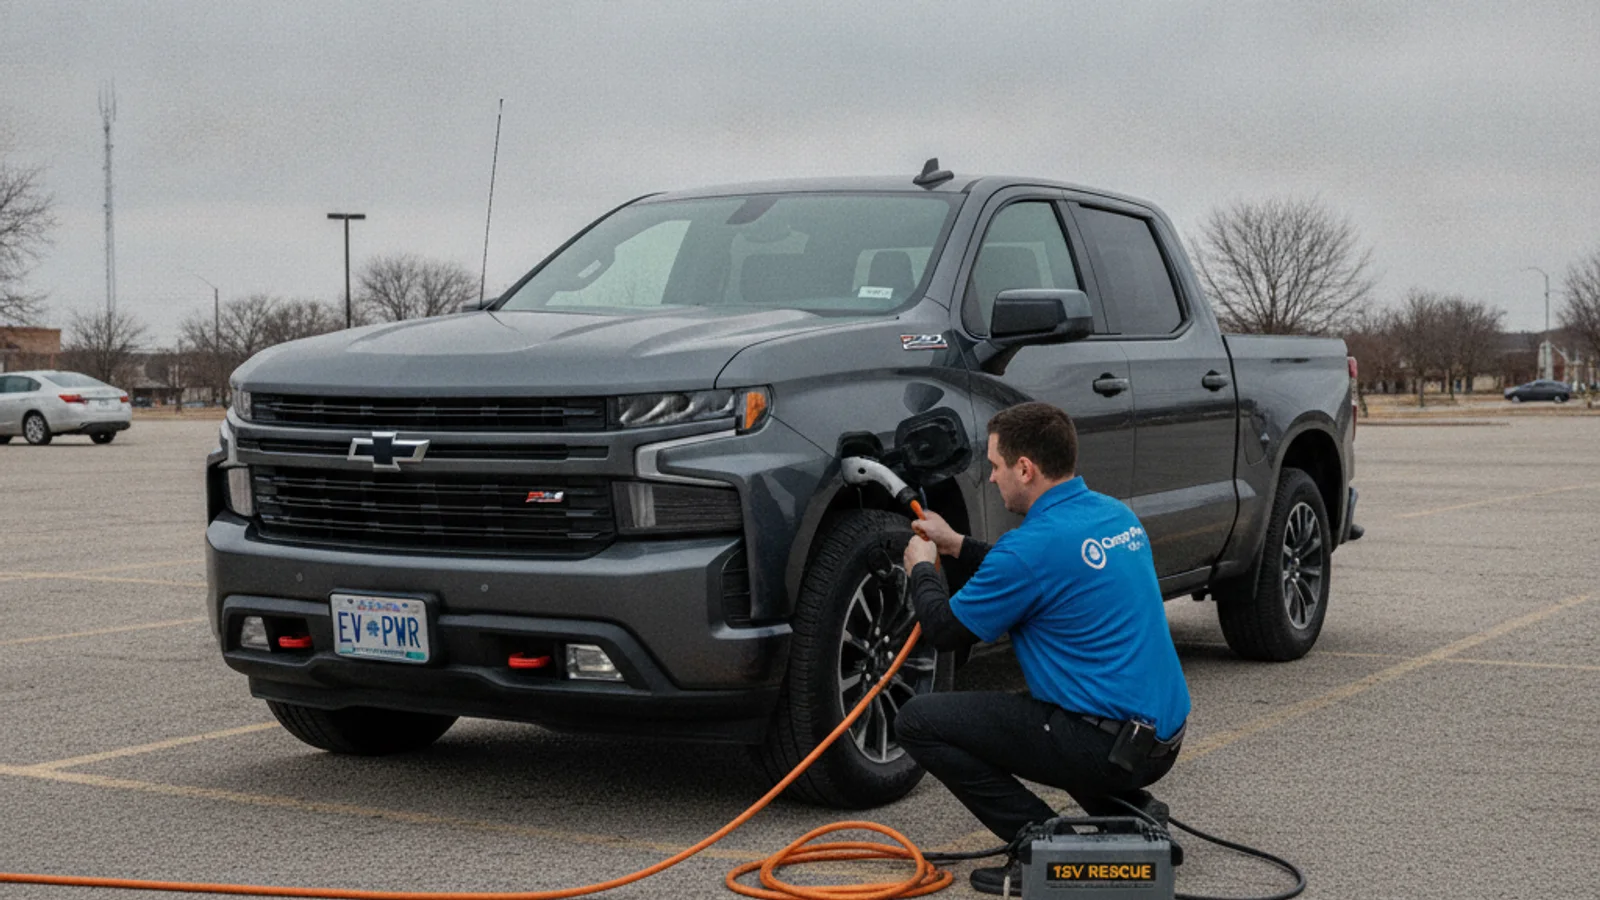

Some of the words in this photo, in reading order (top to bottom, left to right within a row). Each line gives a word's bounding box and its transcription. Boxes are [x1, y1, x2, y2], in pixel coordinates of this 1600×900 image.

[338, 611, 361, 643] EV
[381, 615, 421, 648] PWR
[1088, 865, 1151, 879] RESCUE
